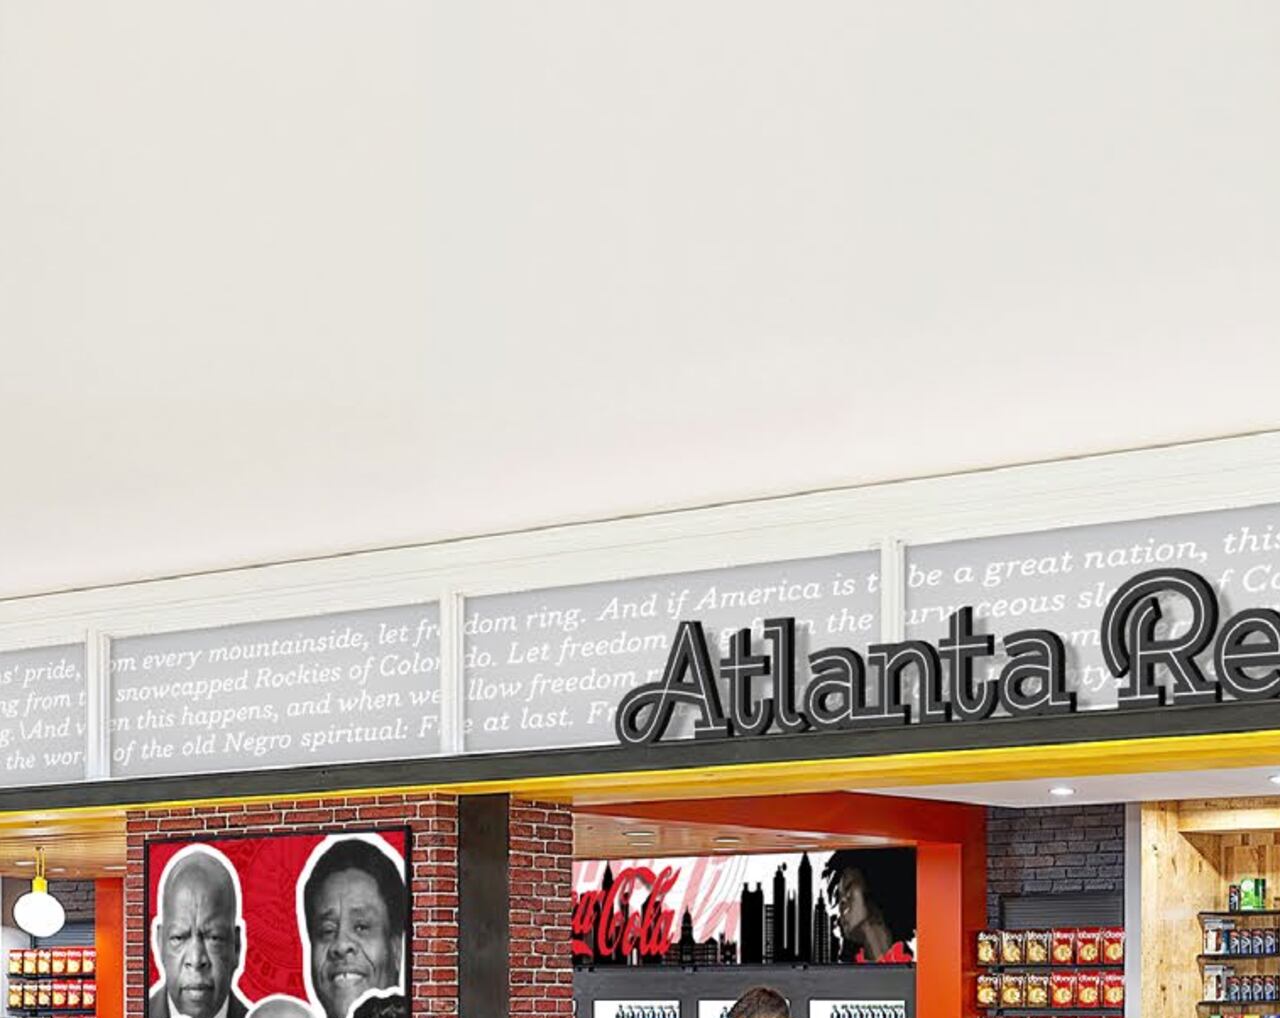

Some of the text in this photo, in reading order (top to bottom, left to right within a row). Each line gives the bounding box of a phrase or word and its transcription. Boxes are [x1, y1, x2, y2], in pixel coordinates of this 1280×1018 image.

[22, 659, 81, 688] pride,
[142, 648, 202, 673] every
[209, 627, 369, 663] mountainside,
[378, 623, 409, 645] let
[526, 604, 587, 634] ring.
[595, 595, 658, 623] And
[665, 589, 690, 623] if
[693, 573, 822, 612] America
[832, 571, 857, 592] is
[907, 564, 941, 588] be
[954, 565, 975, 584] a
[982, 551, 1073, 588] great
[1084, 538, 1207, 566] nation,
[23, 691, 72, 715] from
[116, 669, 249, 703] snowcapped
[255, 665, 341, 690] Rockies
[349, 656, 376, 690] of
[506, 639, 552, 665] Let
[553, 631, 668, 667] freedom
[827, 609, 875, 634] the
[137, 707, 175, 729] this
[182, 703, 279, 728] happens,
[287, 695, 331, 718] and
[339, 690, 402, 712] when
[524, 670, 638, 707] freedom
[615, 606, 1078, 743] Atlanta
[6, 750, 35, 770] the
[114, 739, 136, 767] of
[142, 736, 173, 760] the
[183, 733, 215, 755] old
[222, 732, 292, 757] Negro
[300, 717, 409, 752] spiritual:
[483, 712, 512, 732] at
[520, 705, 574, 730] last.
